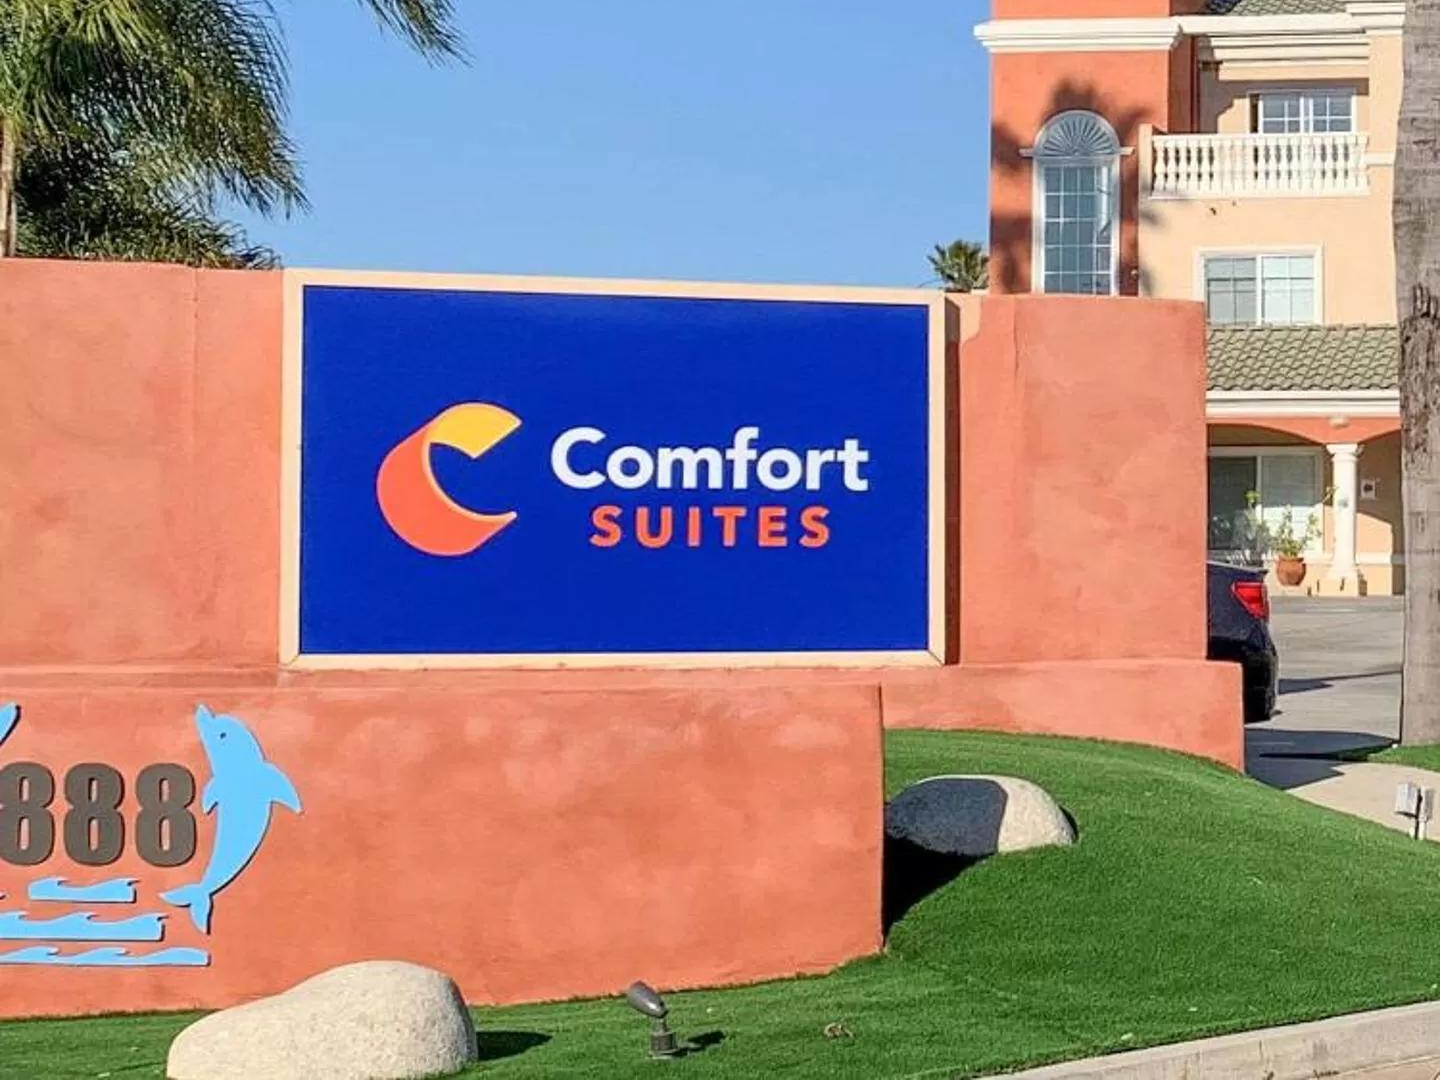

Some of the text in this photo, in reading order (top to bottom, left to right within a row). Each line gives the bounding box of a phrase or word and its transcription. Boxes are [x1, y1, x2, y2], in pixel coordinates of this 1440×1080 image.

[550, 426, 870, 492] Comfort
[589, 505, 831, 549] SUITES
[0, 761, 198, 867] 888
